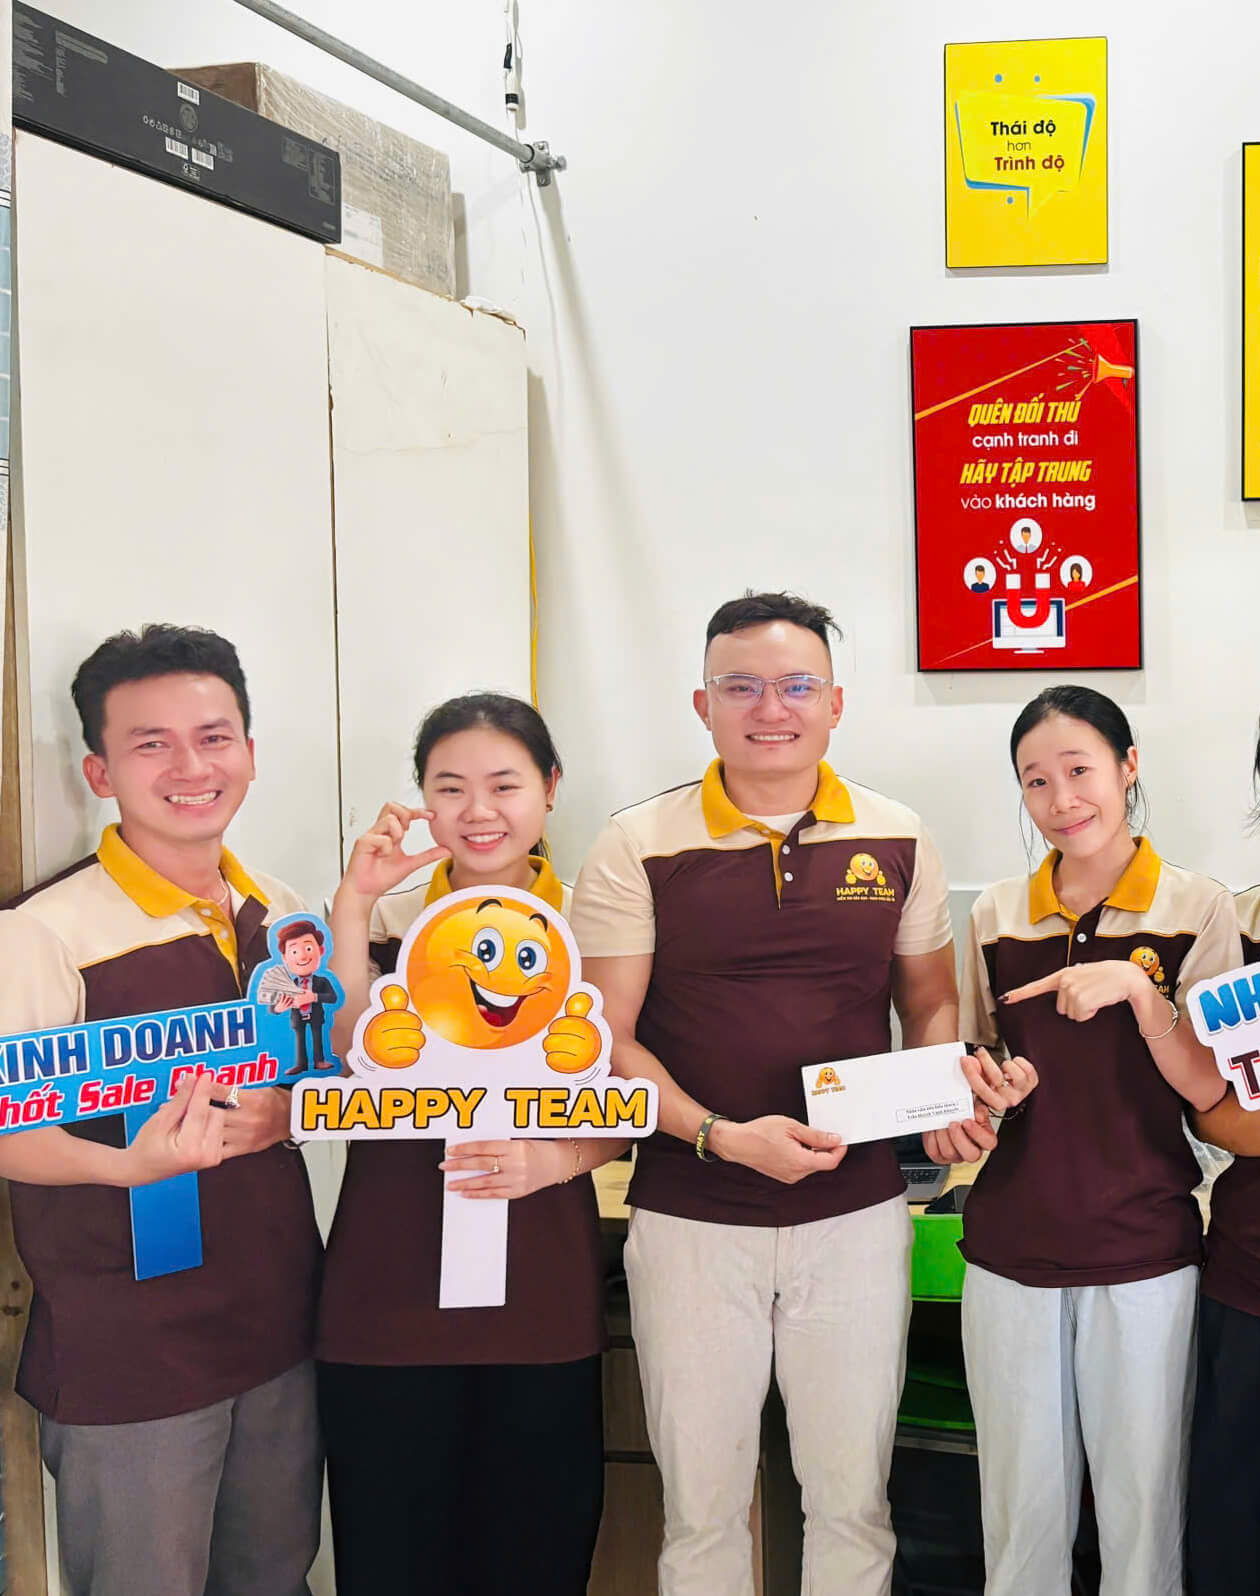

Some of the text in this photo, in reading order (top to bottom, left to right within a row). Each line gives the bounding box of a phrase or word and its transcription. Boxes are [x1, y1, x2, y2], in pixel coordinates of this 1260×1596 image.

[990, 119, 1056, 137] Thái độ
[1007, 140, 1031, 151] hơn
[994, 154, 1065, 172] Trình độ
[968, 393, 1081, 427] QUÊN ĐỐI THỦ
[972, 430, 1078, 451] cạnh tranh đi
[960, 457, 1092, 487] HÃY TẬP TRUNG
[961, 493, 1096, 511] vào khách hàng
[836, 887, 894, 897] HAPPY TEAM
[0, 1005, 257, 1087] INH DOANH
[78, 1074, 155, 1115] Sale
[301, 1087, 648, 1131] HAPPY TEAM
